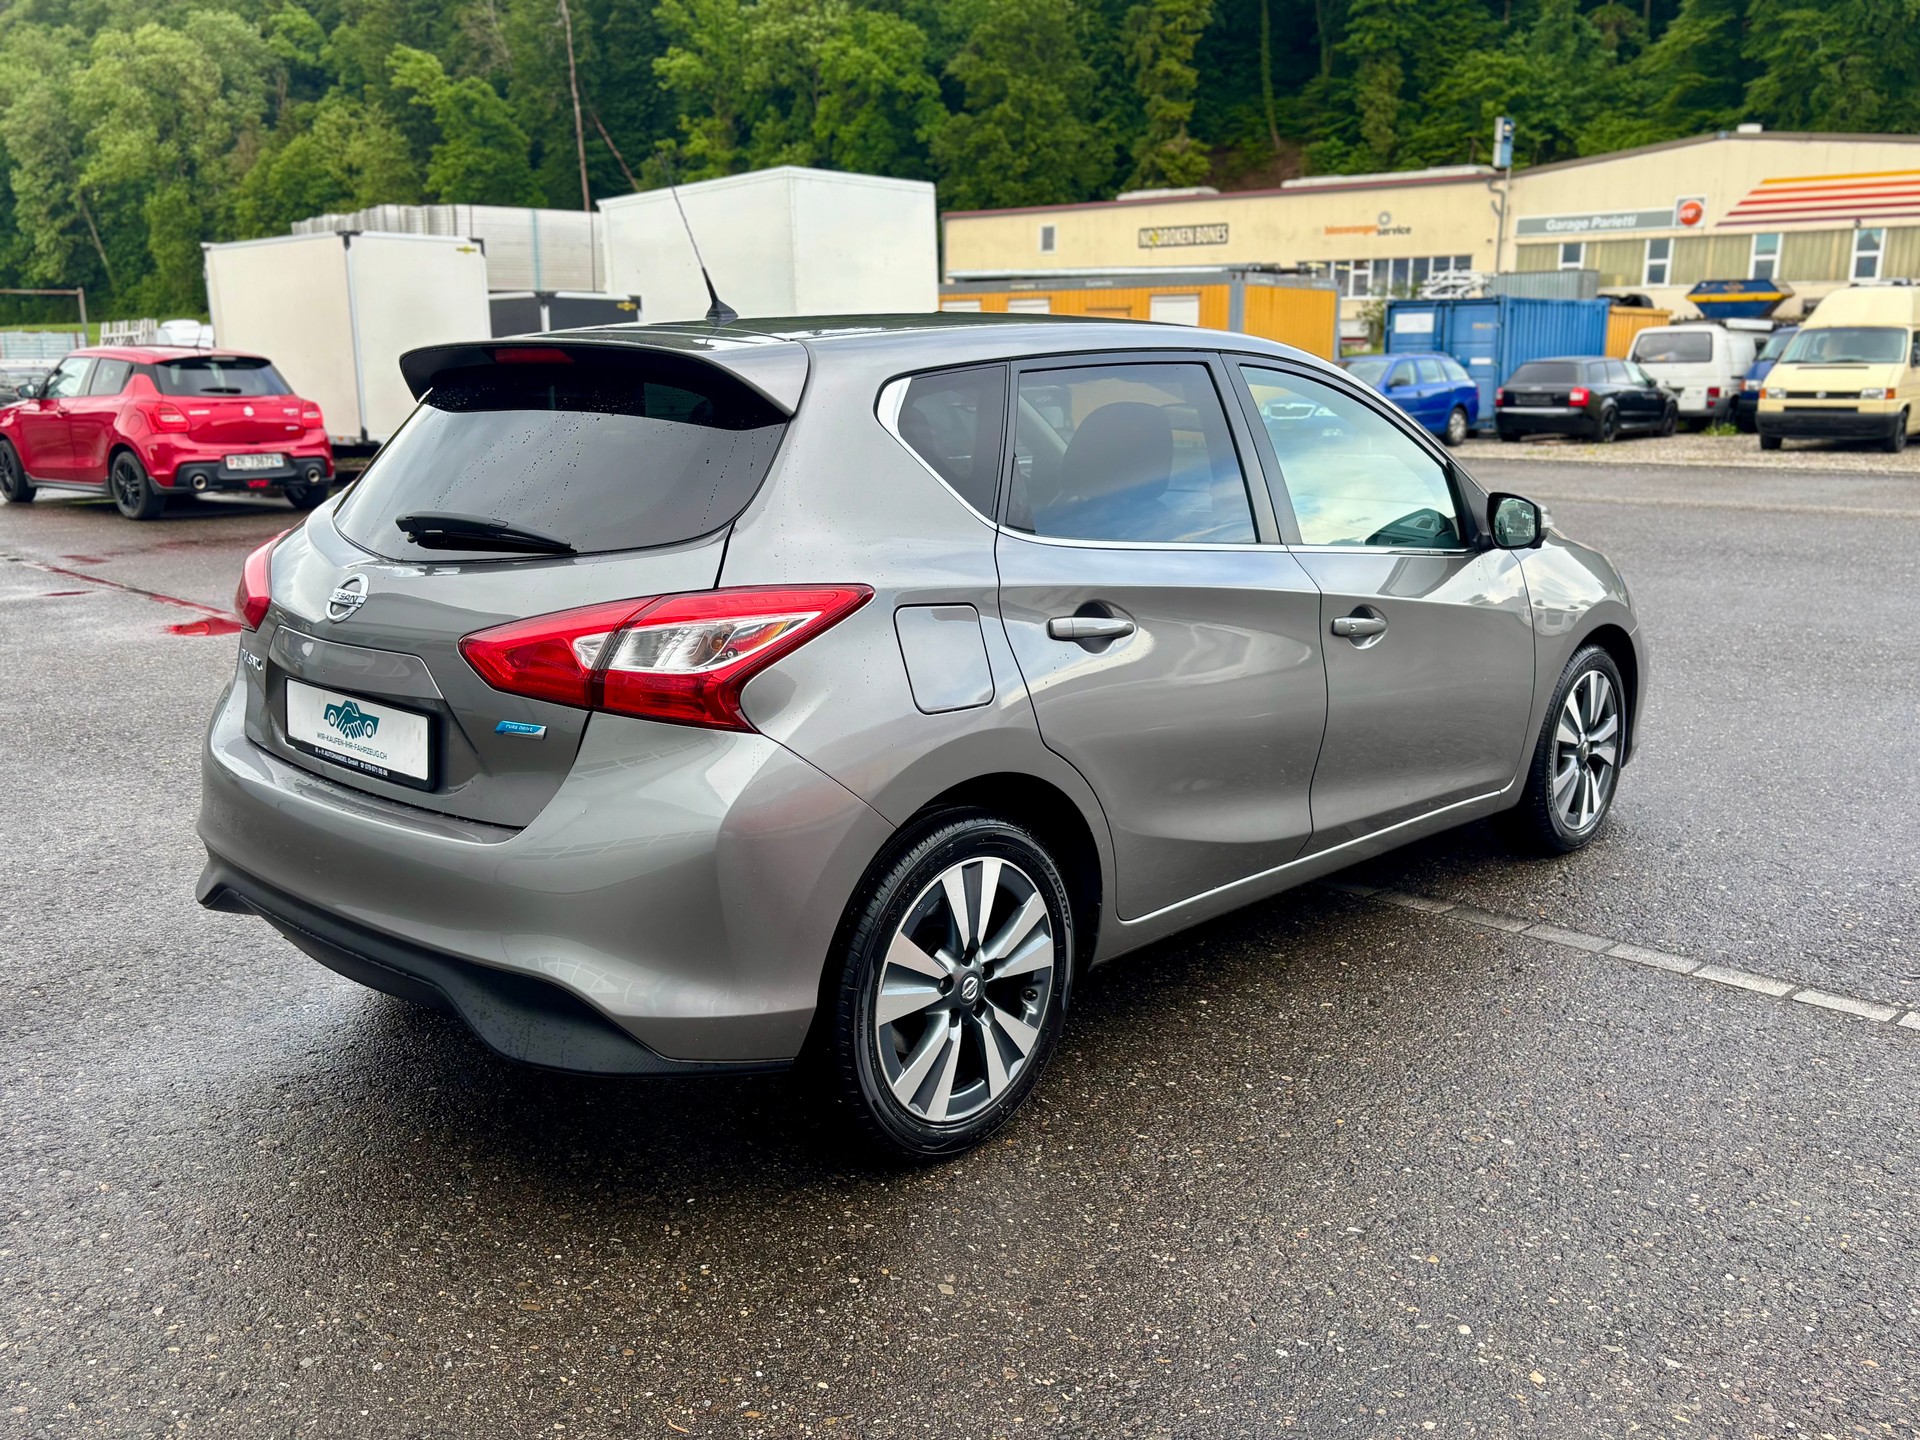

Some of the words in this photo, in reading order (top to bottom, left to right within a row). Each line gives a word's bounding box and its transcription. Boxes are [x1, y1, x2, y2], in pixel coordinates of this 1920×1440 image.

[1545, 216, 1590, 232] Garage
[1591, 213, 1637, 229] Parietti
[1195, 225, 1227, 243] BONES
